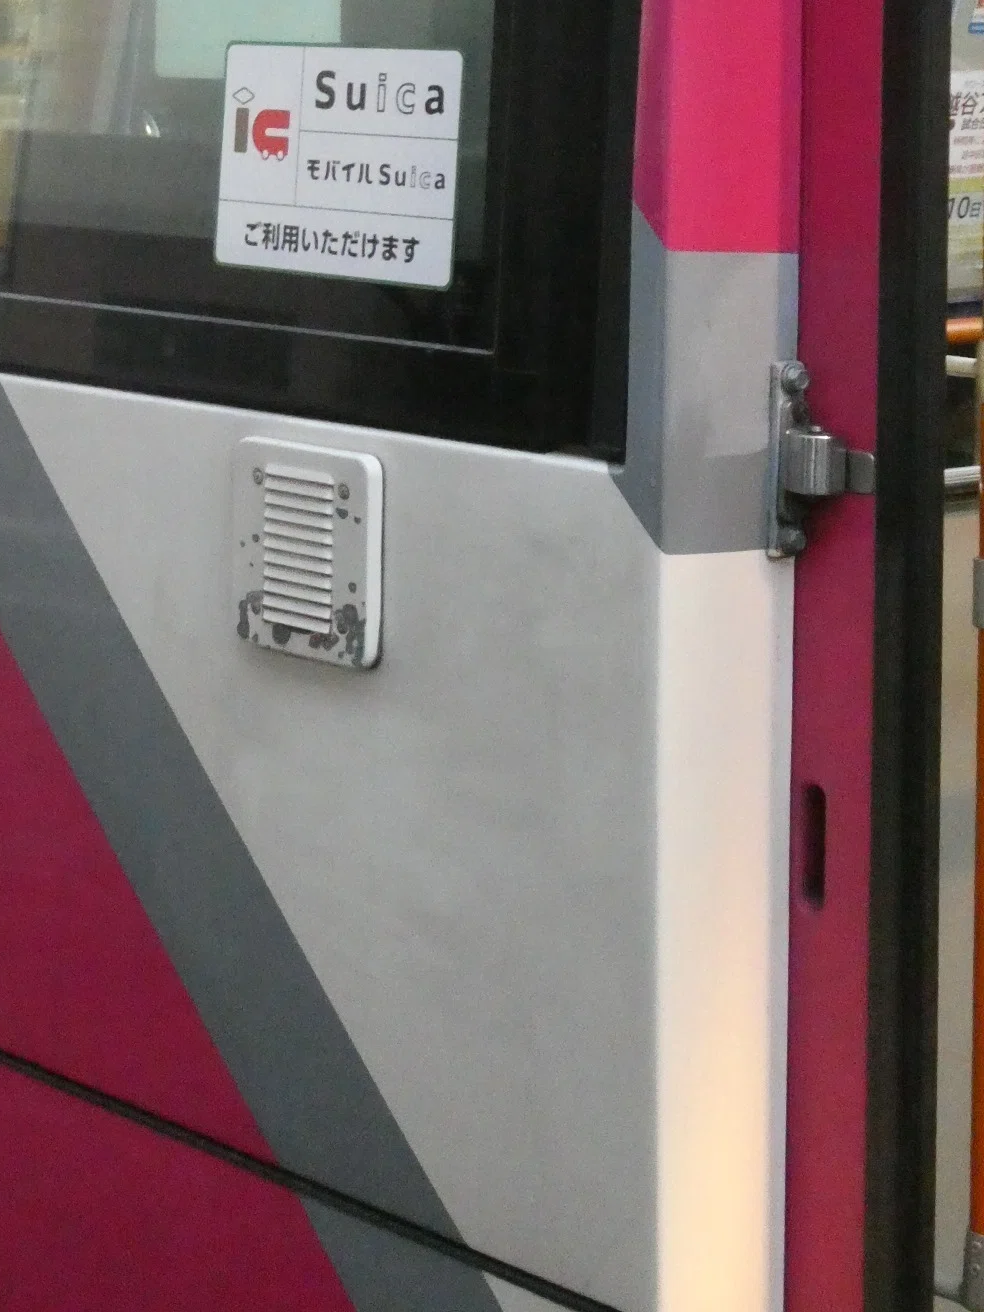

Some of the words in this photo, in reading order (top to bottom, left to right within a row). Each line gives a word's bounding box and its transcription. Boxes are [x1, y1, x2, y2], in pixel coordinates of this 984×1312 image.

[315, 69, 446, 115] Suica
[244, 221, 420, 264] ご利用いただけます
